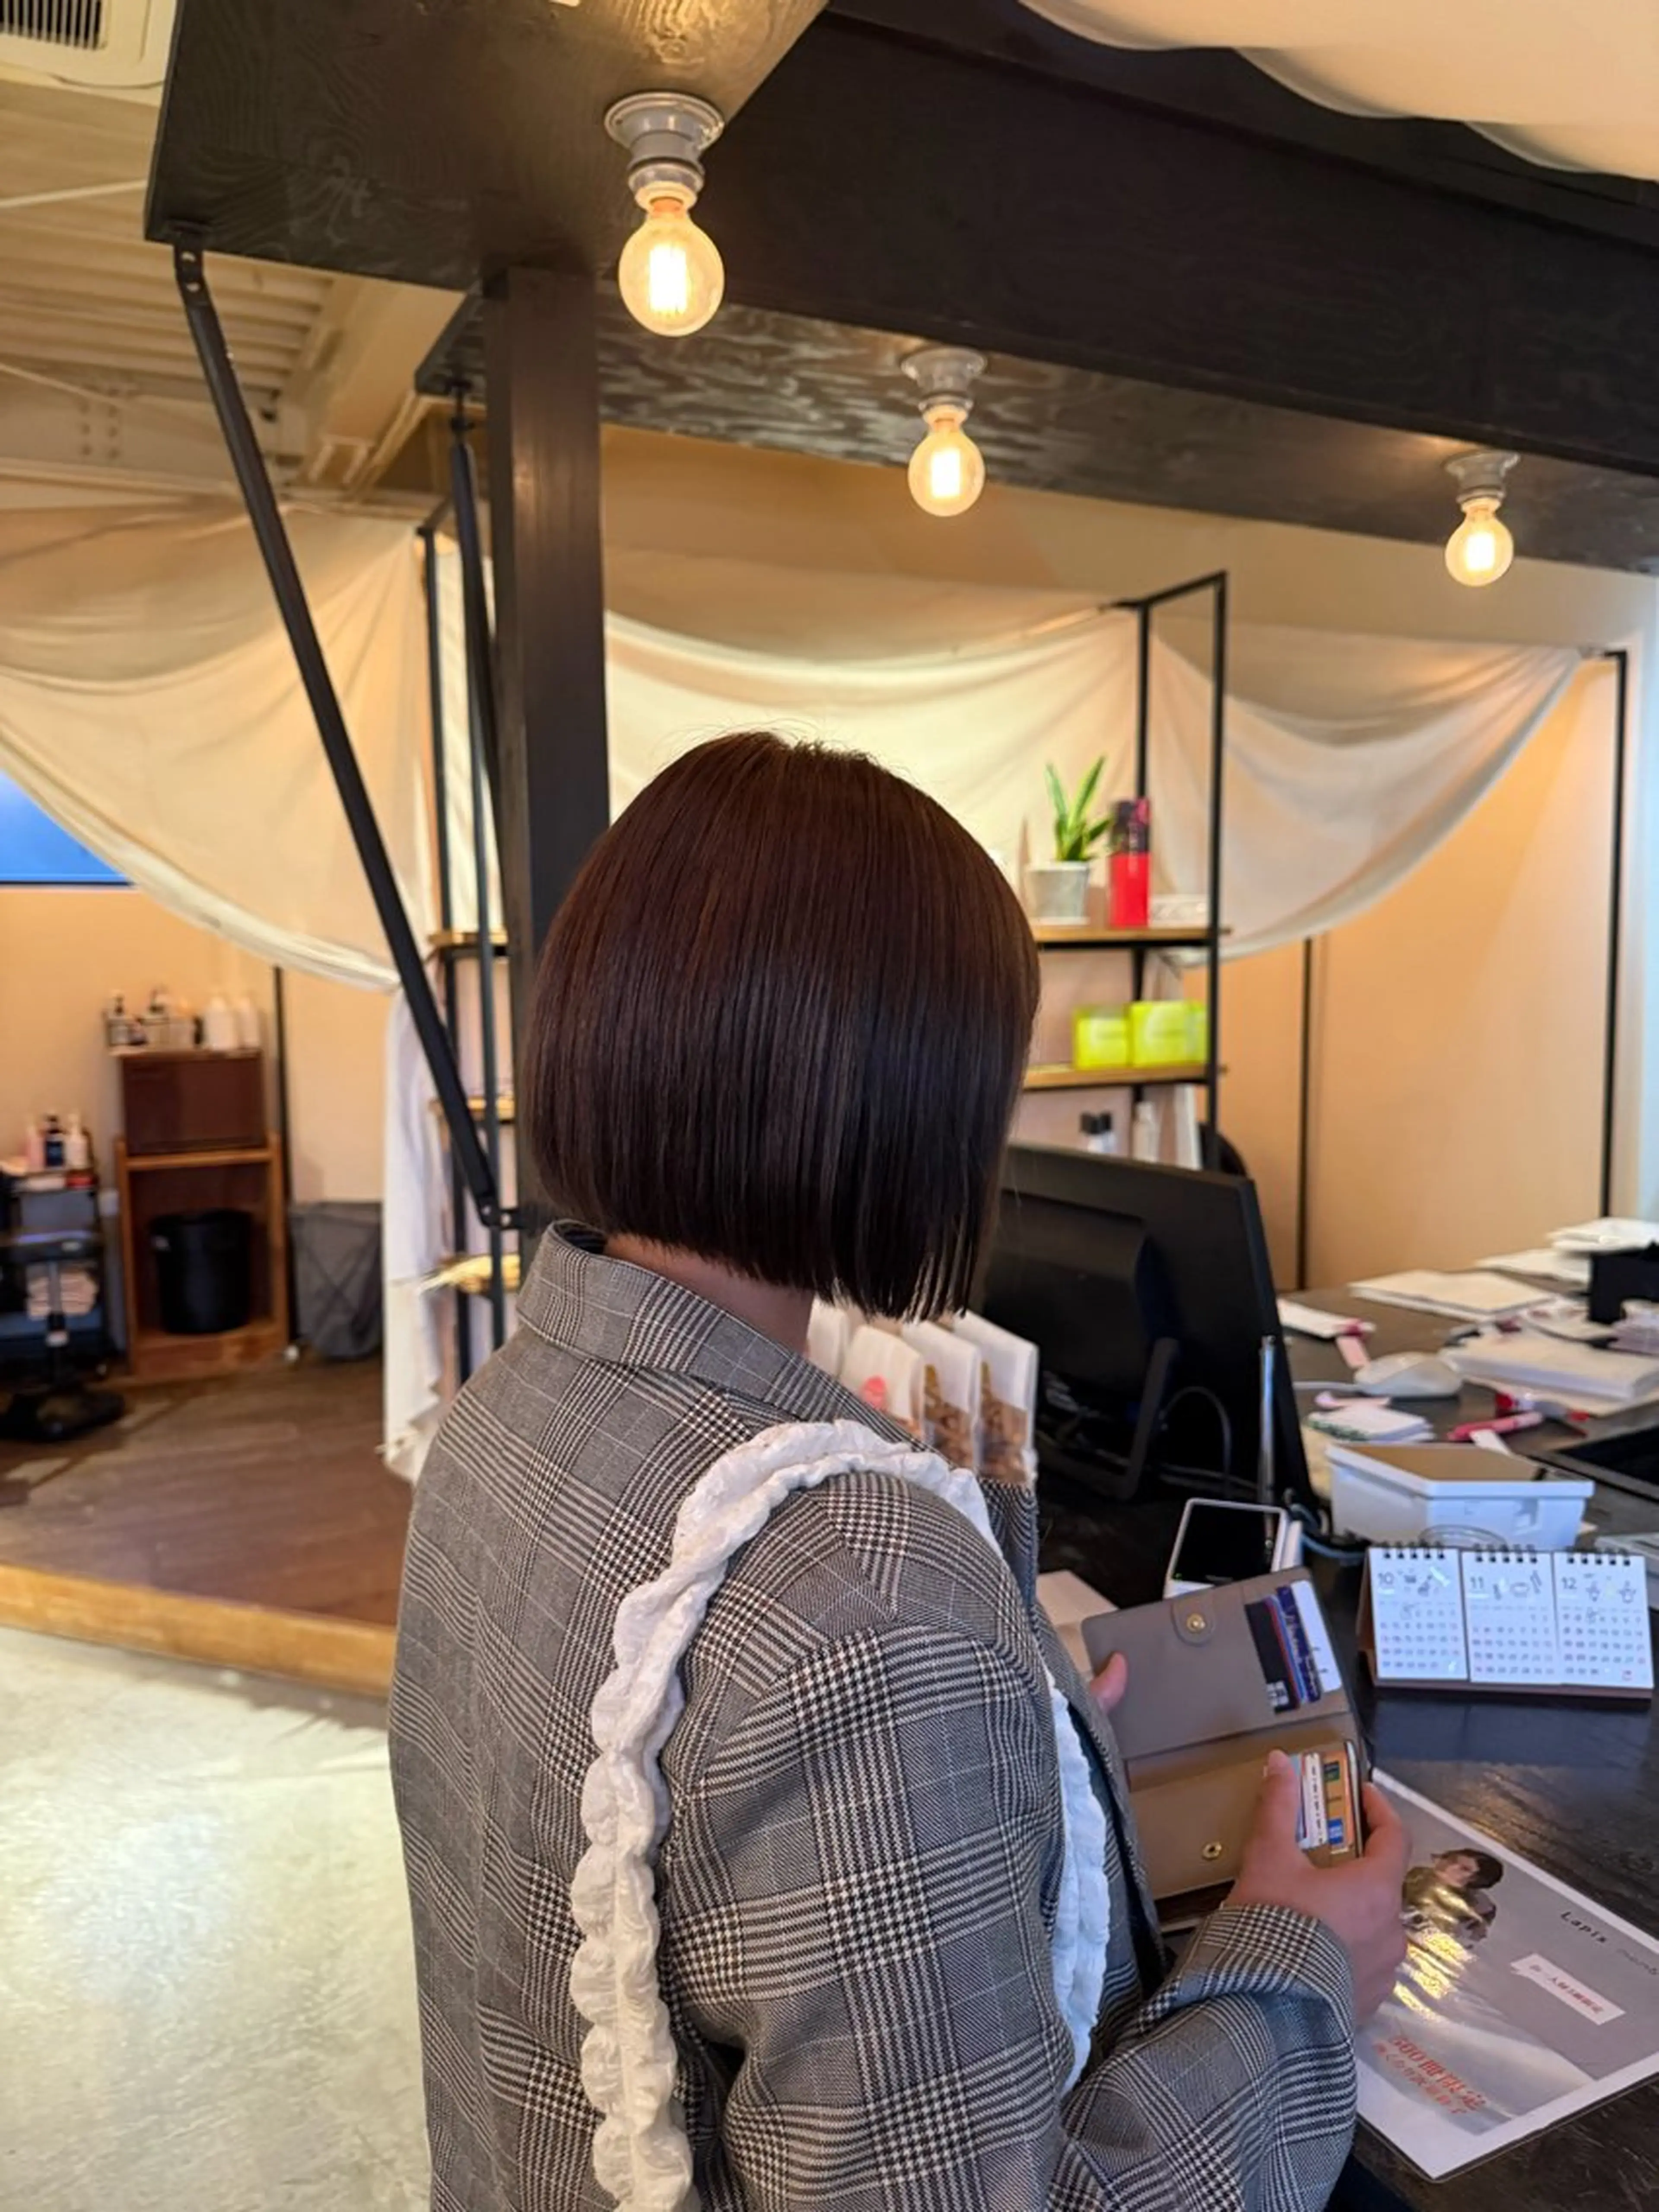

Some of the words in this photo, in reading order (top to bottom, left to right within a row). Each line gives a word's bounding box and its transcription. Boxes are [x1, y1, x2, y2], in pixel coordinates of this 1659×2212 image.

[1378, 1571, 1394, 1585] 10
[1470, 1576, 1484, 1589] 11
[1561, 1576, 1577, 1589] 12
[1560, 1911, 1607, 1943] Lapis
